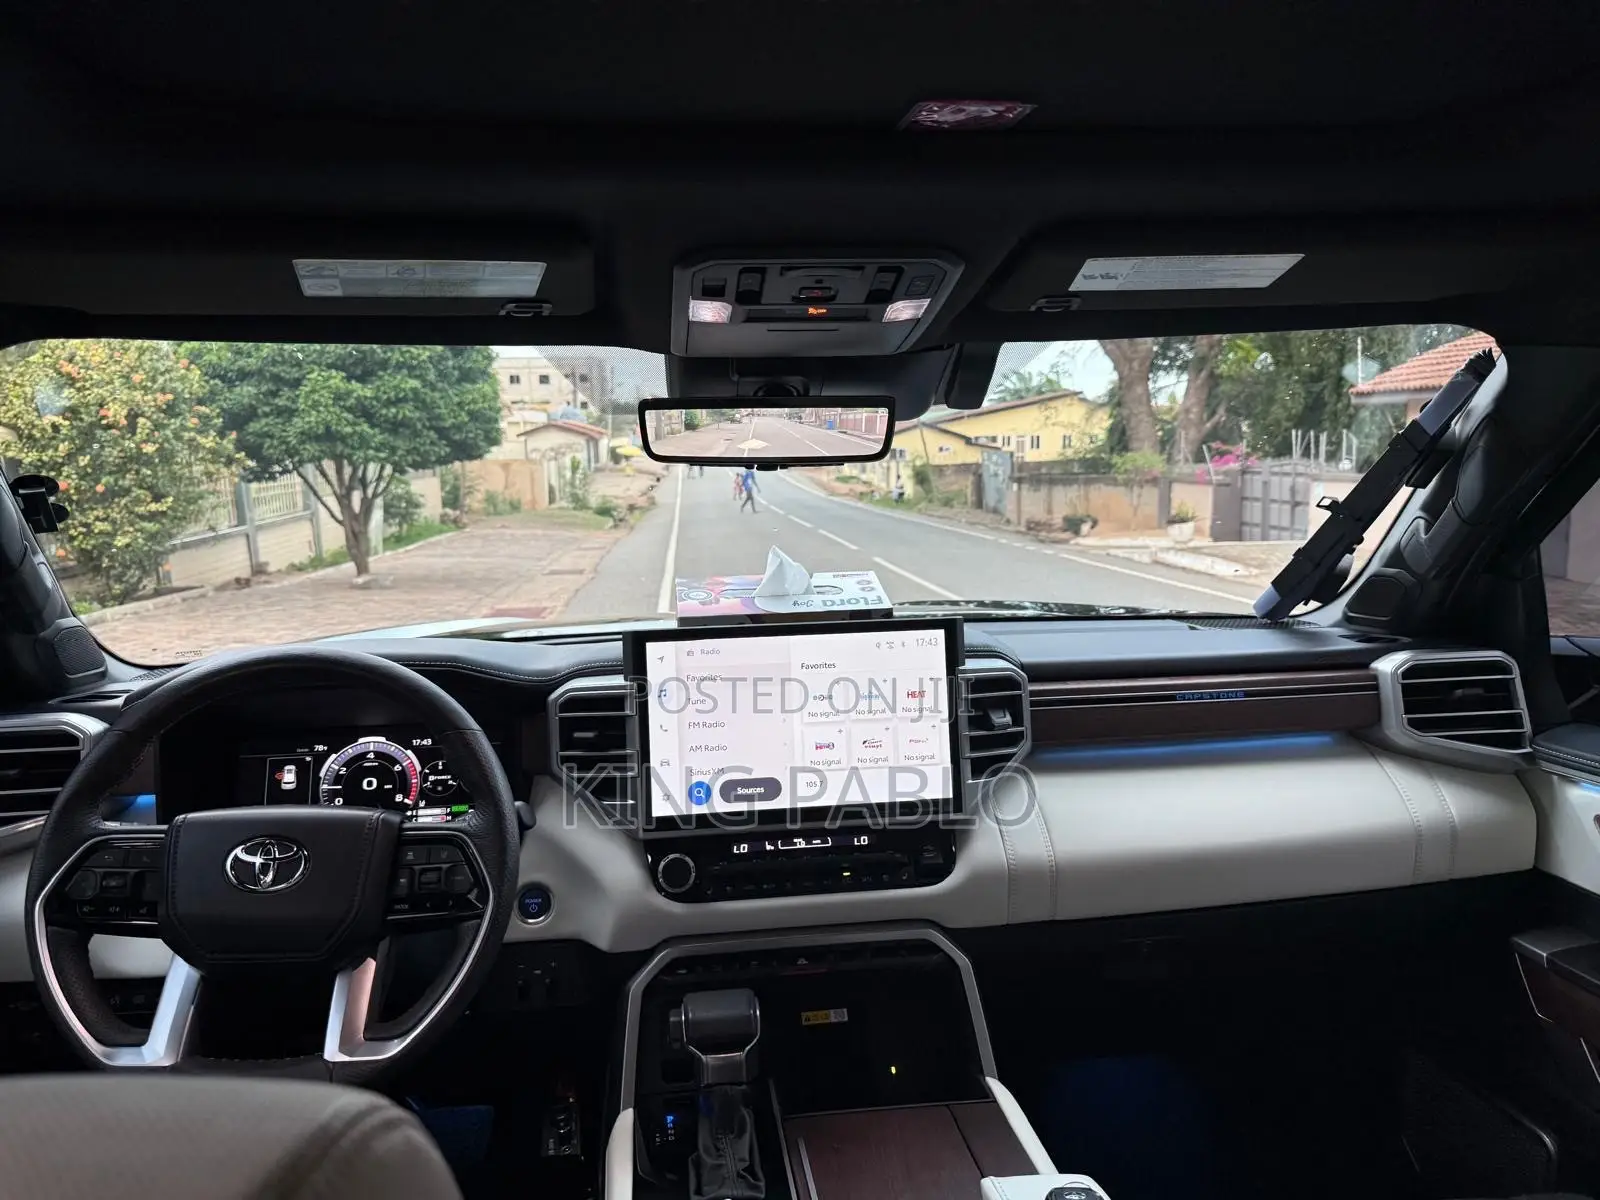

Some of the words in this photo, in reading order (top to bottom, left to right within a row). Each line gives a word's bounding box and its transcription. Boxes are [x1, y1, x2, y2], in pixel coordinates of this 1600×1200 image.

[915, 637, 938, 647] 17:43
[801, 662, 837, 670] Favorites
[686, 673, 722, 683] Favorites
[906, 690, 927, 699] HEAT
[1176, 690, 1245, 701] CAPSTONE
[687, 697, 707, 706] Tune
[819, 710, 841, 719] signal
[688, 721, 702, 730] FM
[702, 720, 726, 729] Radio
[412, 738, 432, 746] 17:43
[688, 745, 703, 753] AM
[704, 744, 728, 752] Radio
[868, 756, 889, 765] signal
[915, 753, 936, 762] signal
[821, 758, 842, 767] signal
[338, 767, 347, 775] 2
[394, 764, 402, 772] 6
[689, 767, 725, 777] SiriusXM
[362, 777, 378, 790] 0
[805, 780, 823, 788] 105.7
[737, 786, 765, 795] Sources
[334, 797, 343, 805] 0
[395, 794, 403, 802] 8
[854, 836, 868, 846] LO
[733, 843, 748, 853] LO
